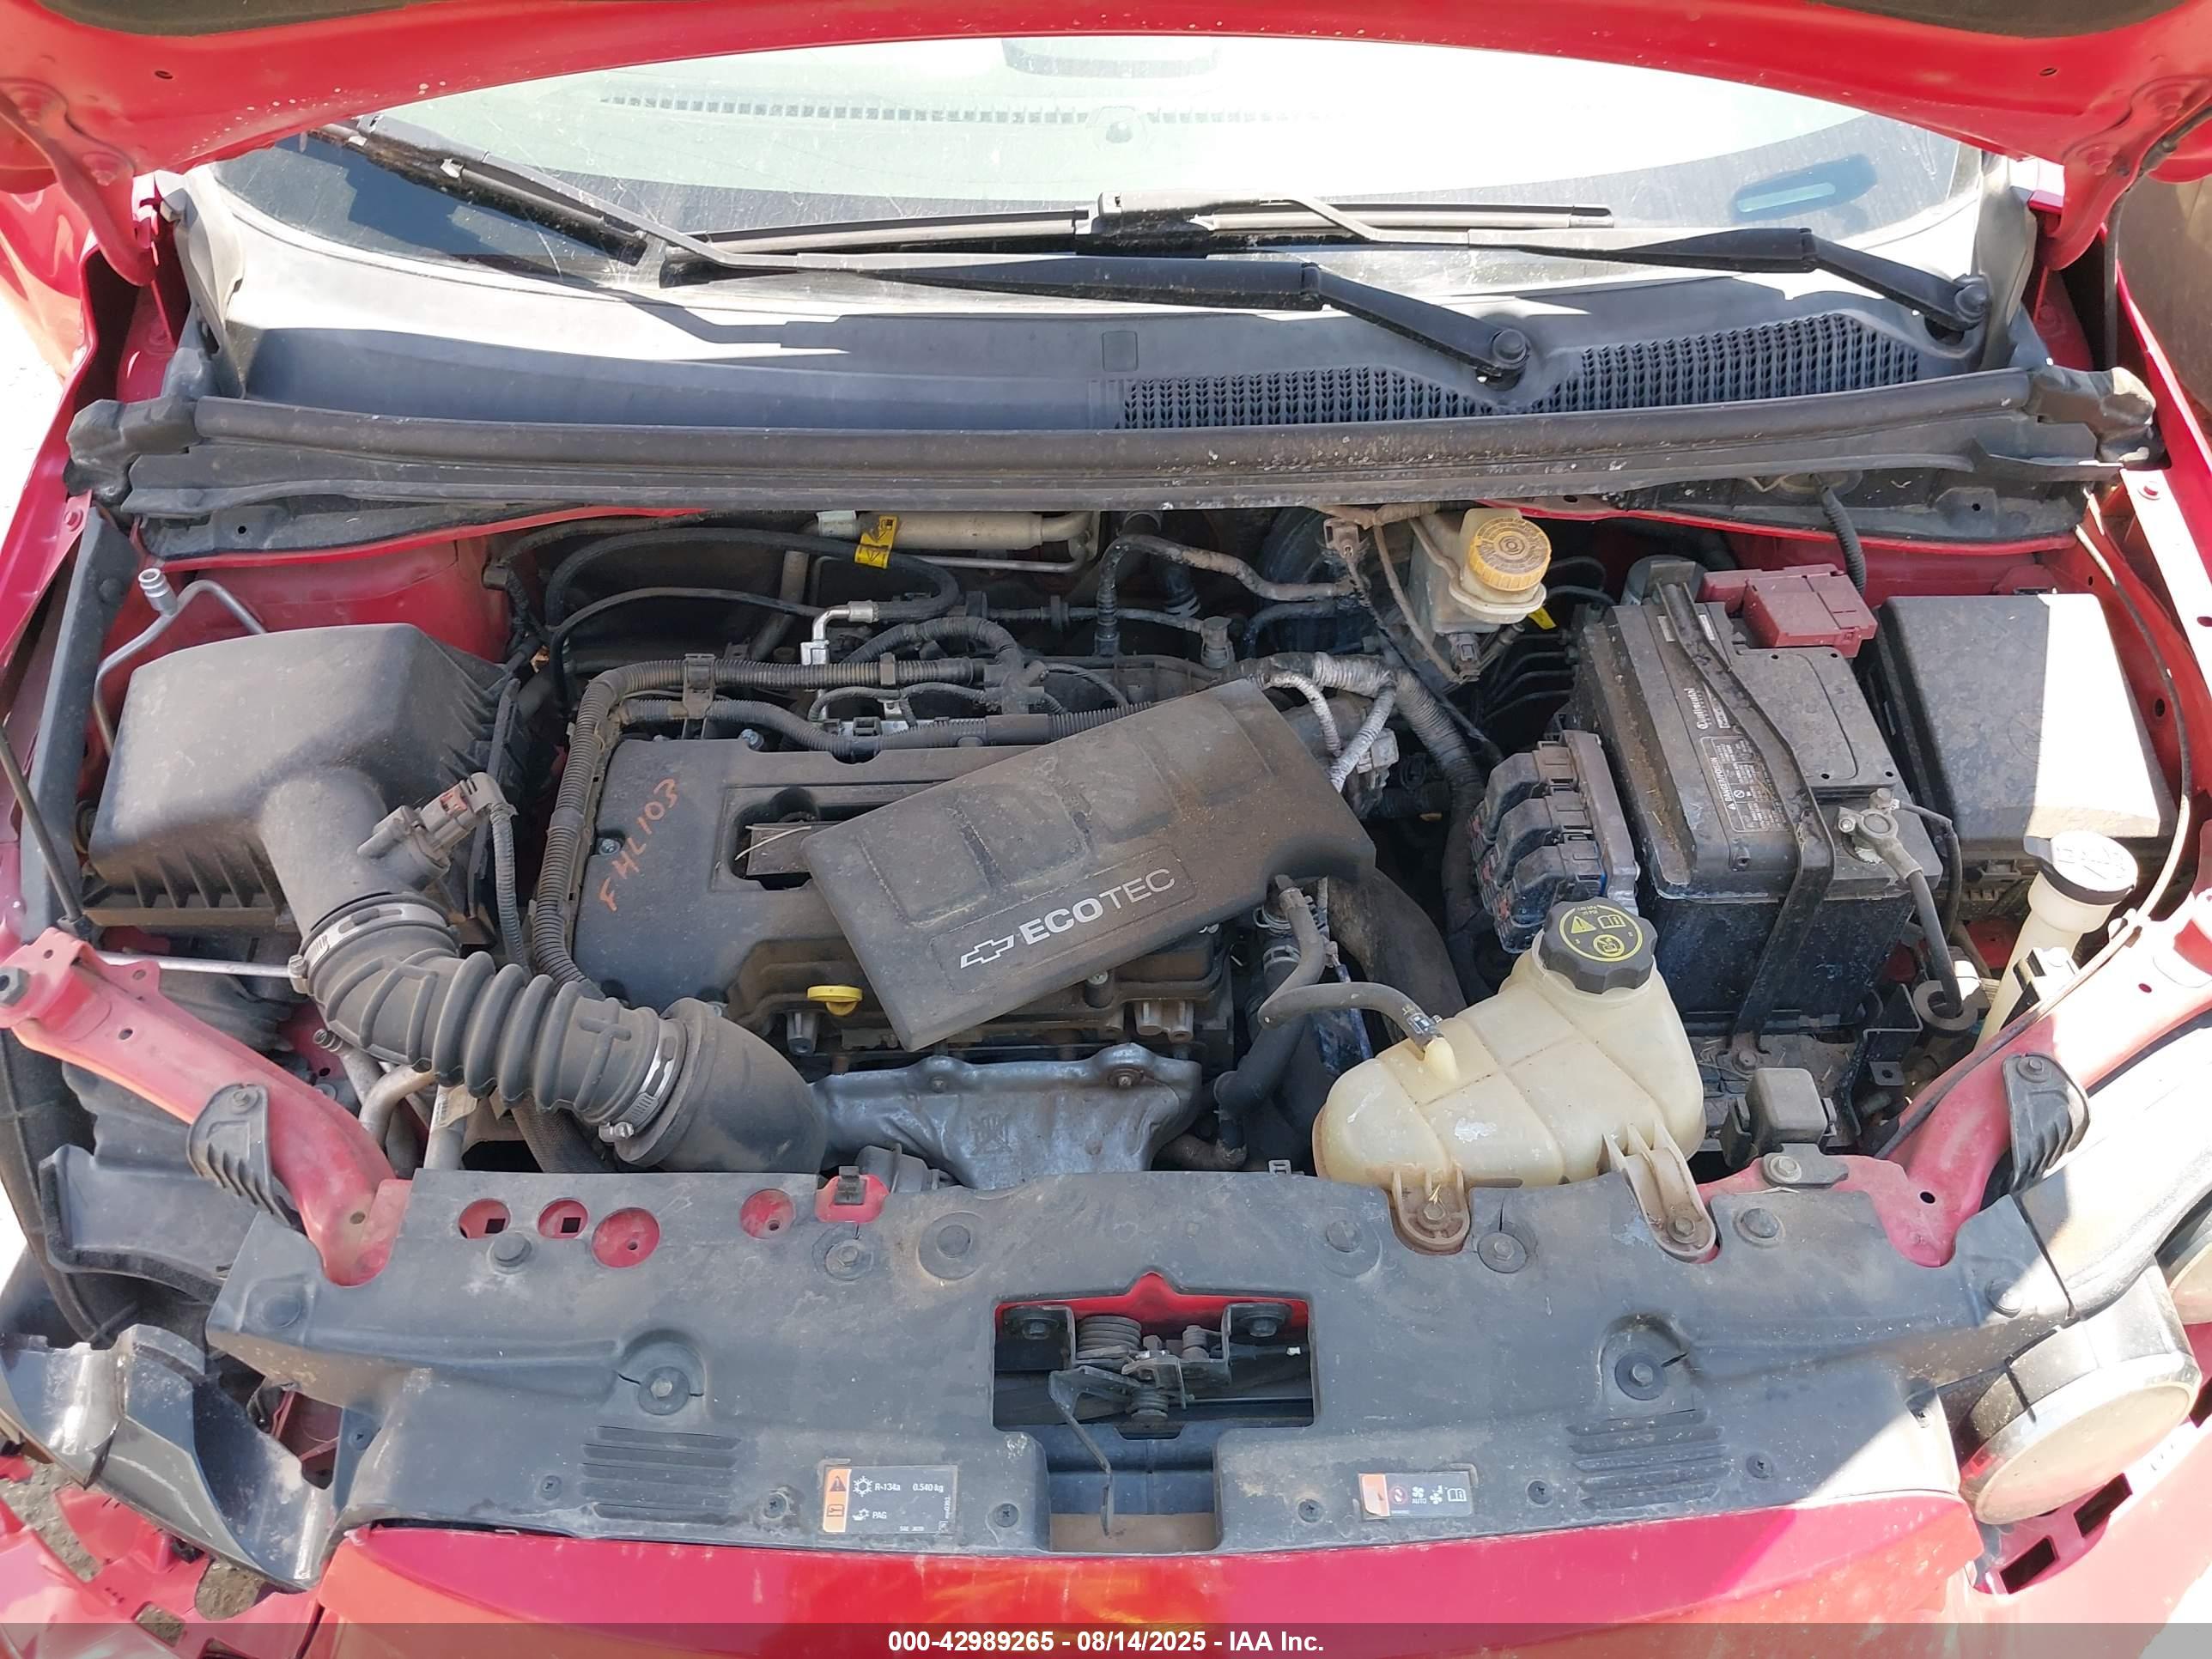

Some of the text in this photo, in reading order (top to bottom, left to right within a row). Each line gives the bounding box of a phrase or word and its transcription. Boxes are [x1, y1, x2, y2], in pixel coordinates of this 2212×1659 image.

[1018, 868, 1176, 945] ECOTEC
[874, 1483, 944, 1493] R-134a 0.540 kg
[872, 1510, 887, 1519] PAG
